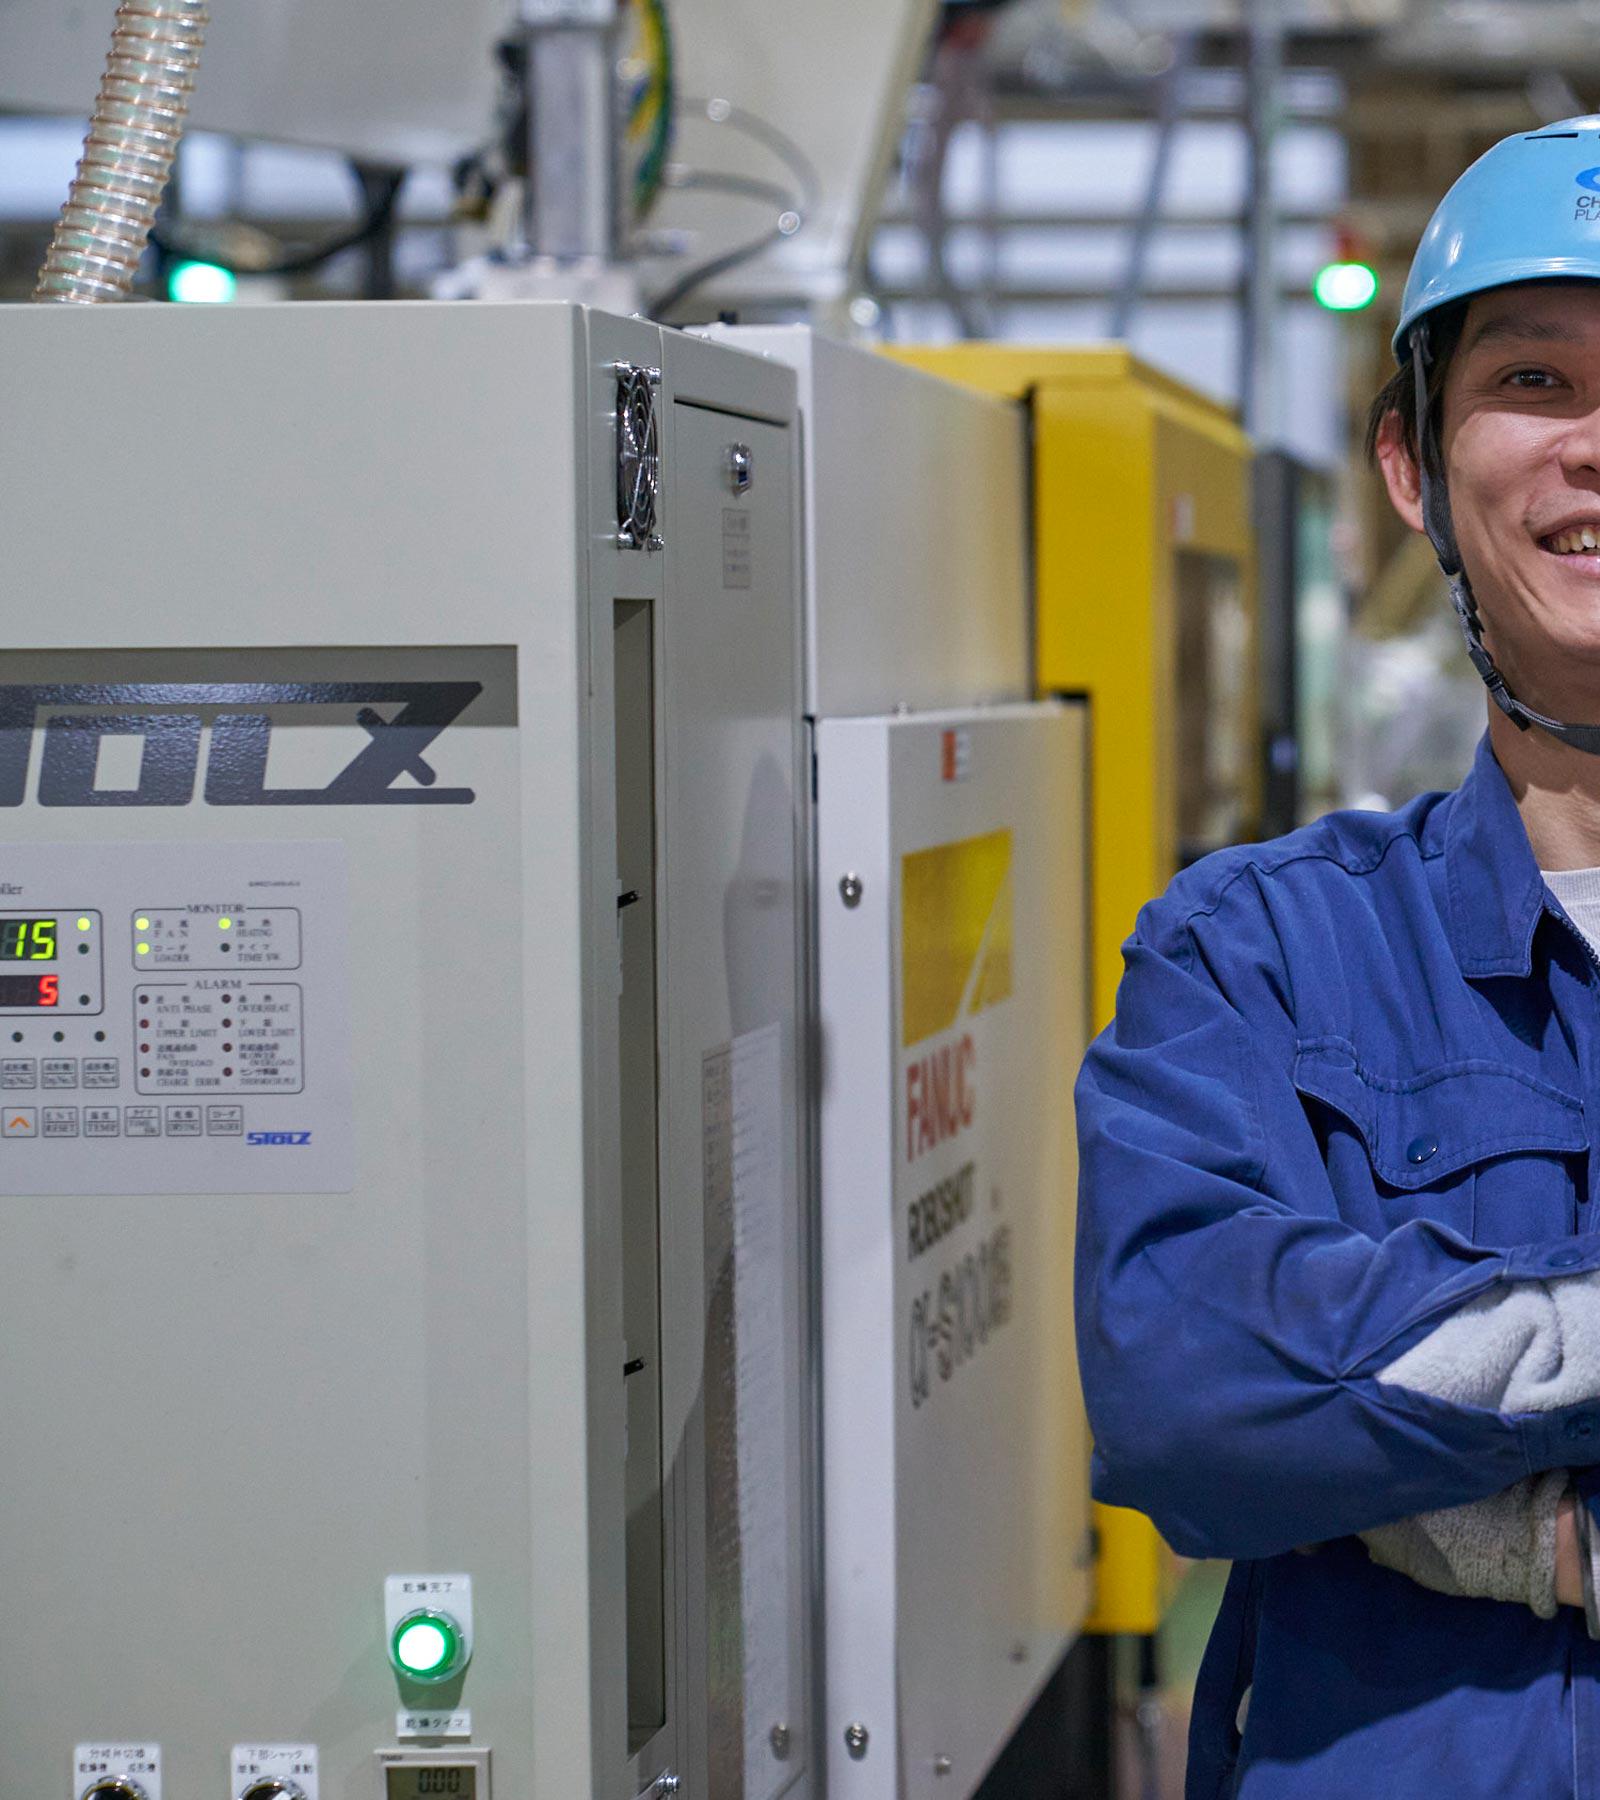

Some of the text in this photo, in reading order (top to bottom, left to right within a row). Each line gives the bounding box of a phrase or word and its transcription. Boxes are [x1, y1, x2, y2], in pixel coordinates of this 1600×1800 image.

[187, 904, 245, 913] MONITOR
[194, 979, 242, 989] ALARM
[907, 1034, 976, 1163] FANUC
[247, 1131, 312, 1145] STOLZ
